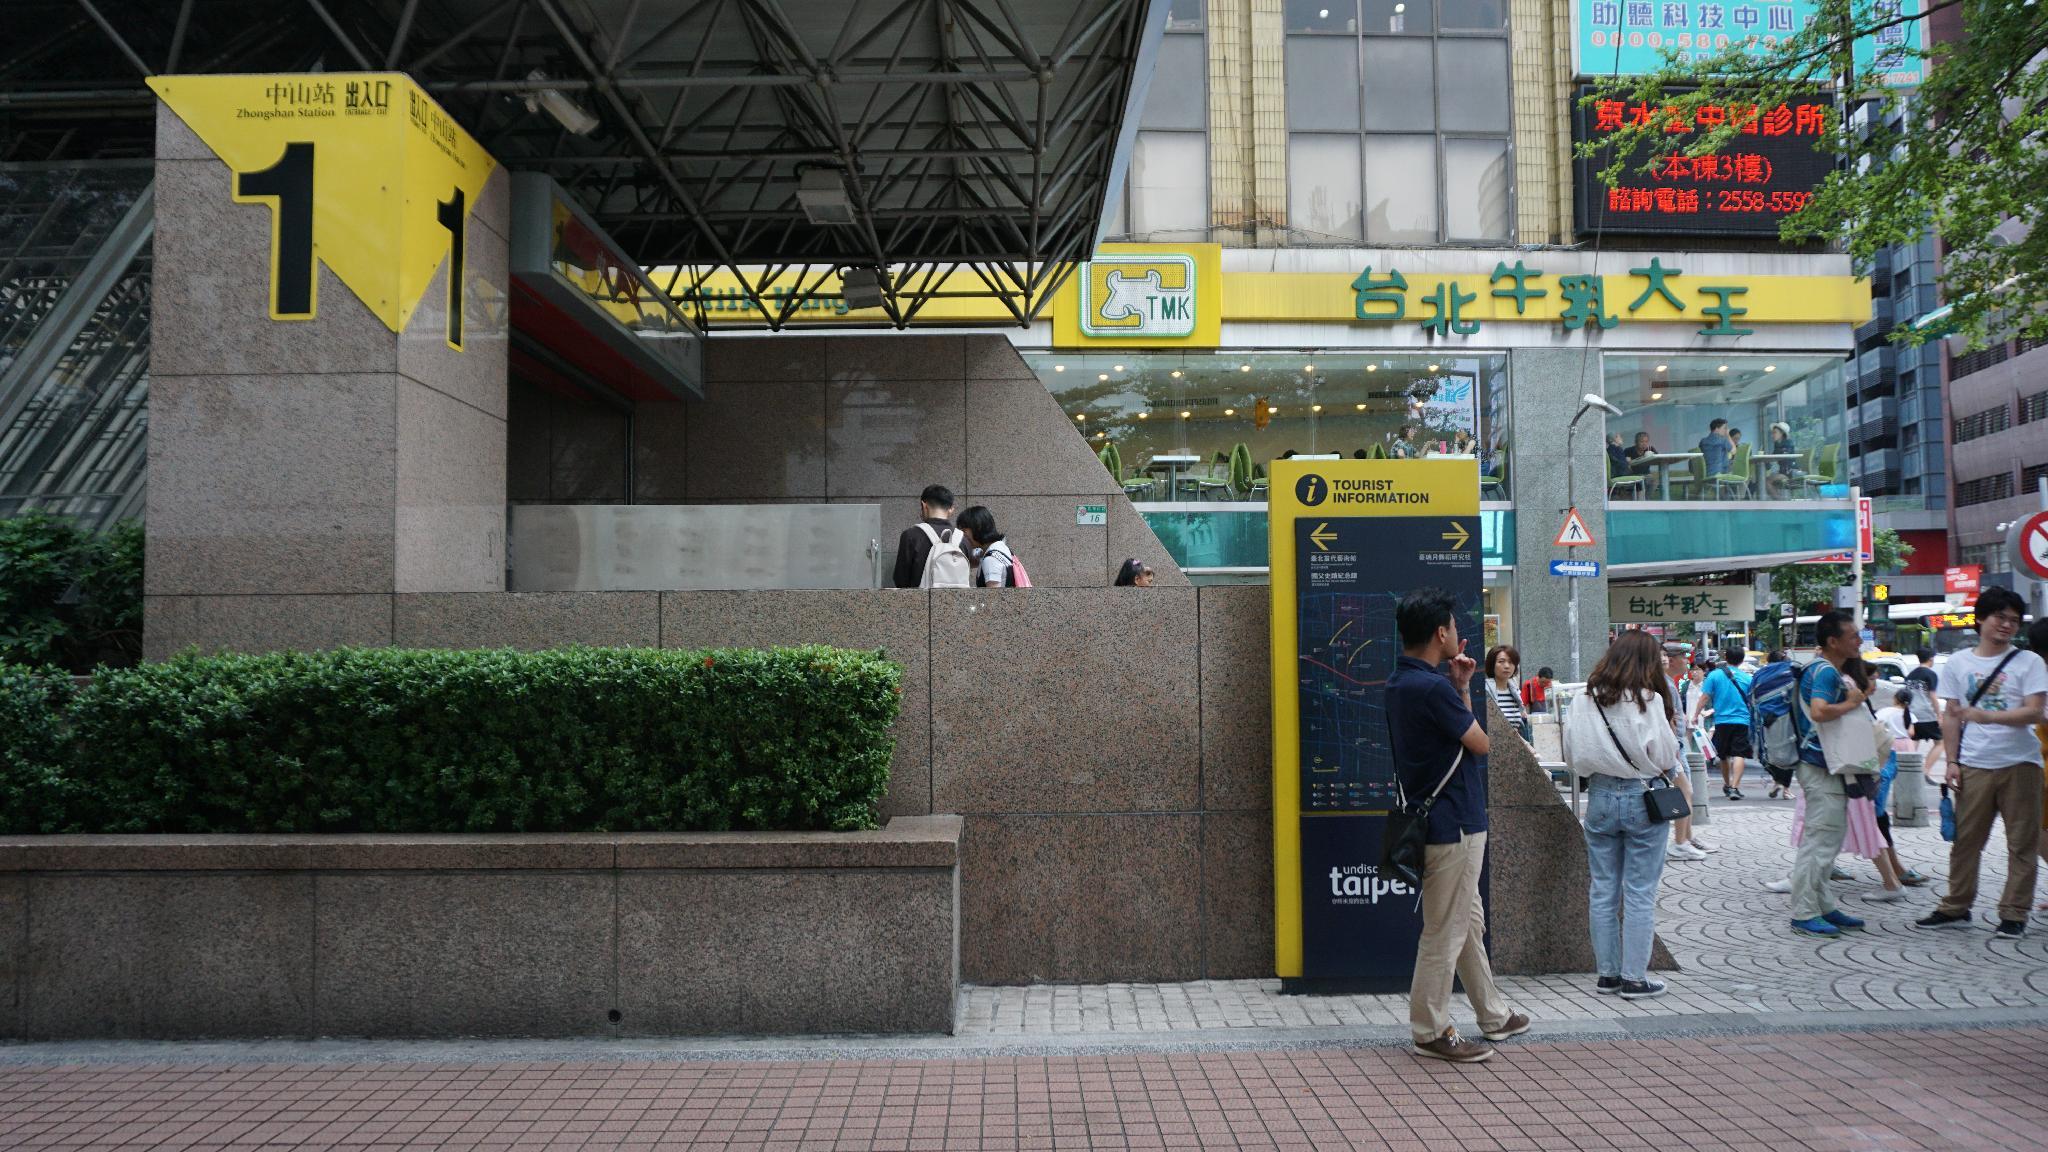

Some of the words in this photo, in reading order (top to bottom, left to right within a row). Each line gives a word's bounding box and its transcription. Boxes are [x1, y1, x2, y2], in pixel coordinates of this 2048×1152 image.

[1592, 2, 1795, 32] 助聽科技中心
[266, 82, 335, 105] 中山站
[345, 80, 392, 108] 出入口
[236, 107, 294, 120] Zhongshan
[297, 107, 336, 117] Station
[409, 89, 428, 129] 出入口
[430, 111, 457, 150] 中山站
[238, 142, 314, 314] 1
[437, 186, 465, 346] 1
[1146, 295, 1191, 321] TMK
[1351, 256, 1754, 337] 台北牛乳大王
[1333, 479, 1394, 491] TOURIST
[1333, 492, 1429, 504] INFORMATION
[1090, 514, 1101, 523] 16
[1628, 591, 1729, 617] 台北牛乳大王
